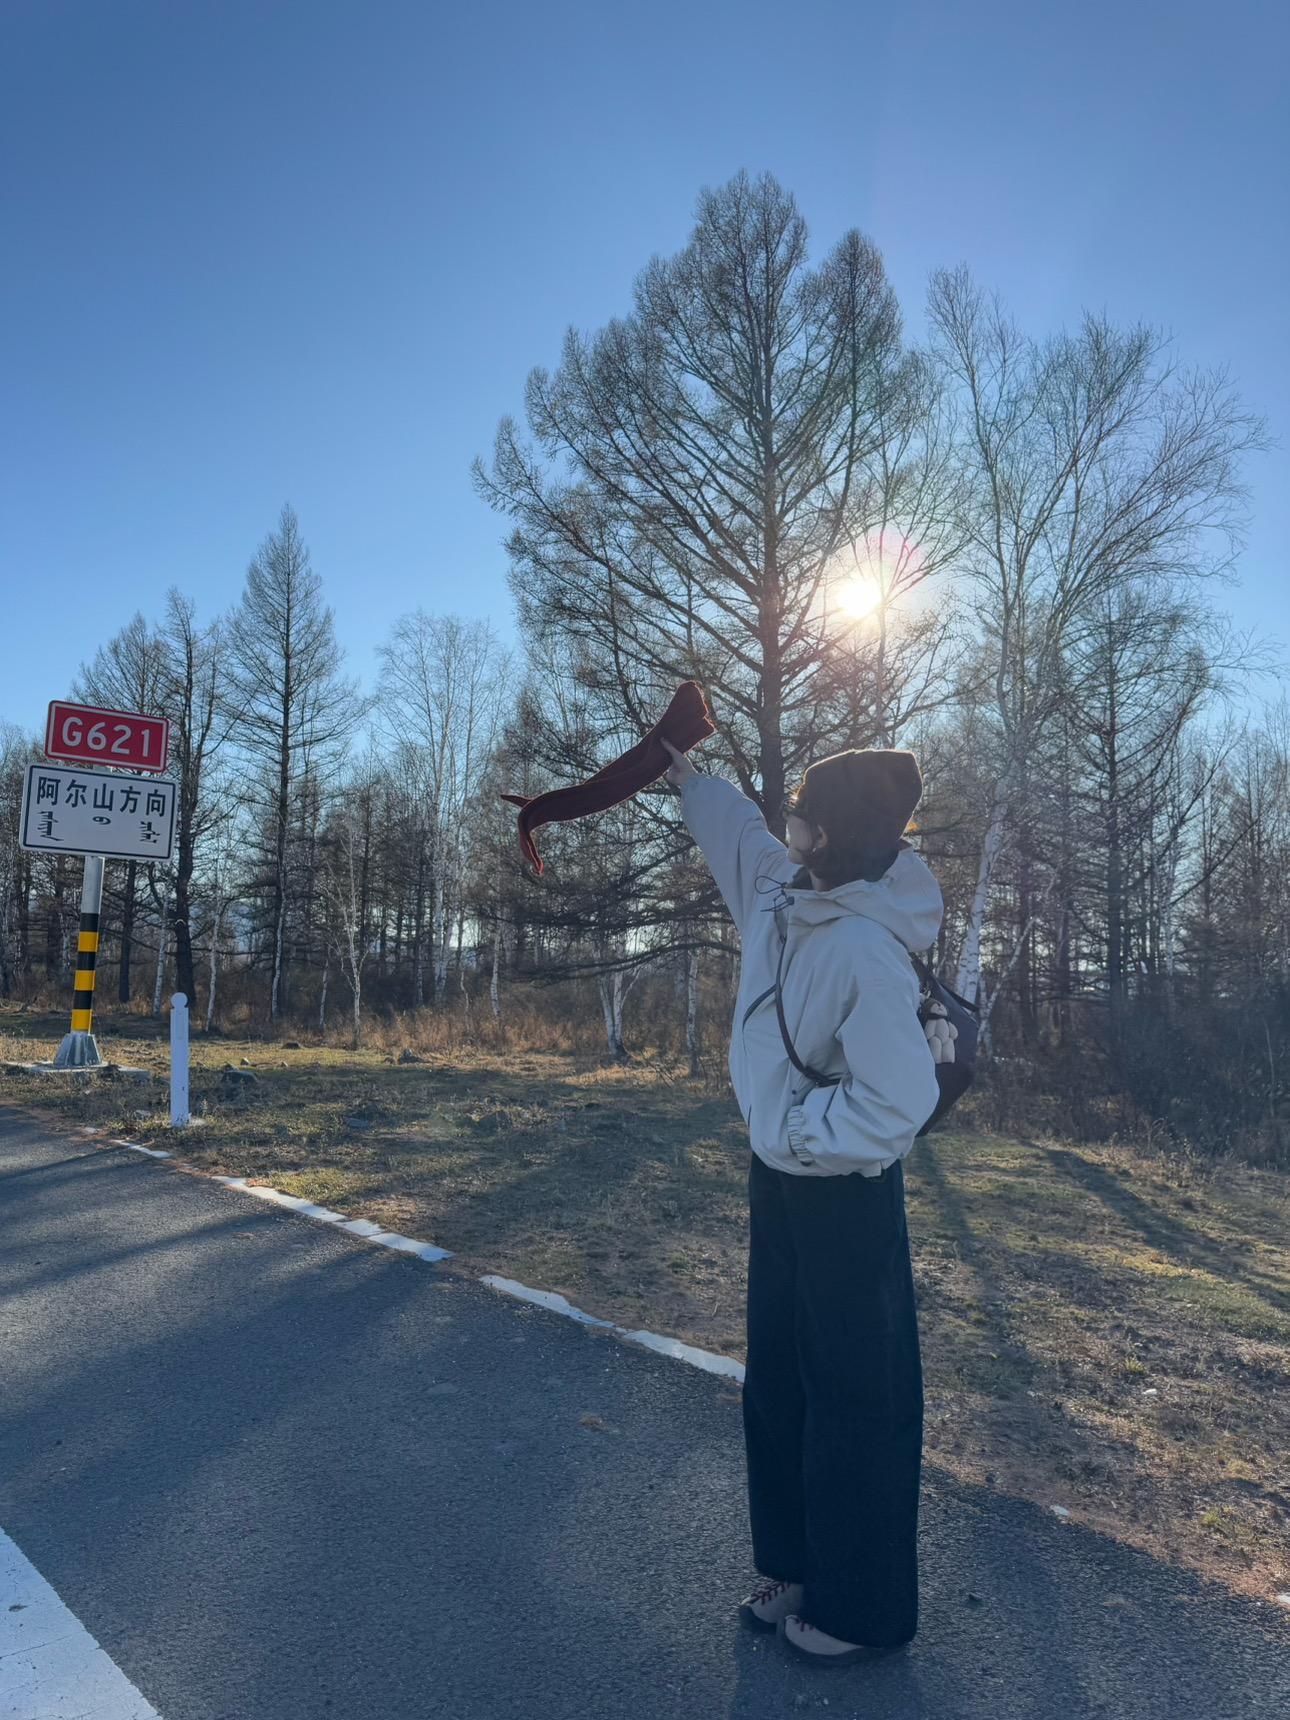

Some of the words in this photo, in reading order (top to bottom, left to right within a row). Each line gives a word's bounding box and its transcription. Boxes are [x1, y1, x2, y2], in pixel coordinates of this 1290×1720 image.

[62, 716, 150, 757] G621
[36, 776, 166, 817] 阿尔山方向
